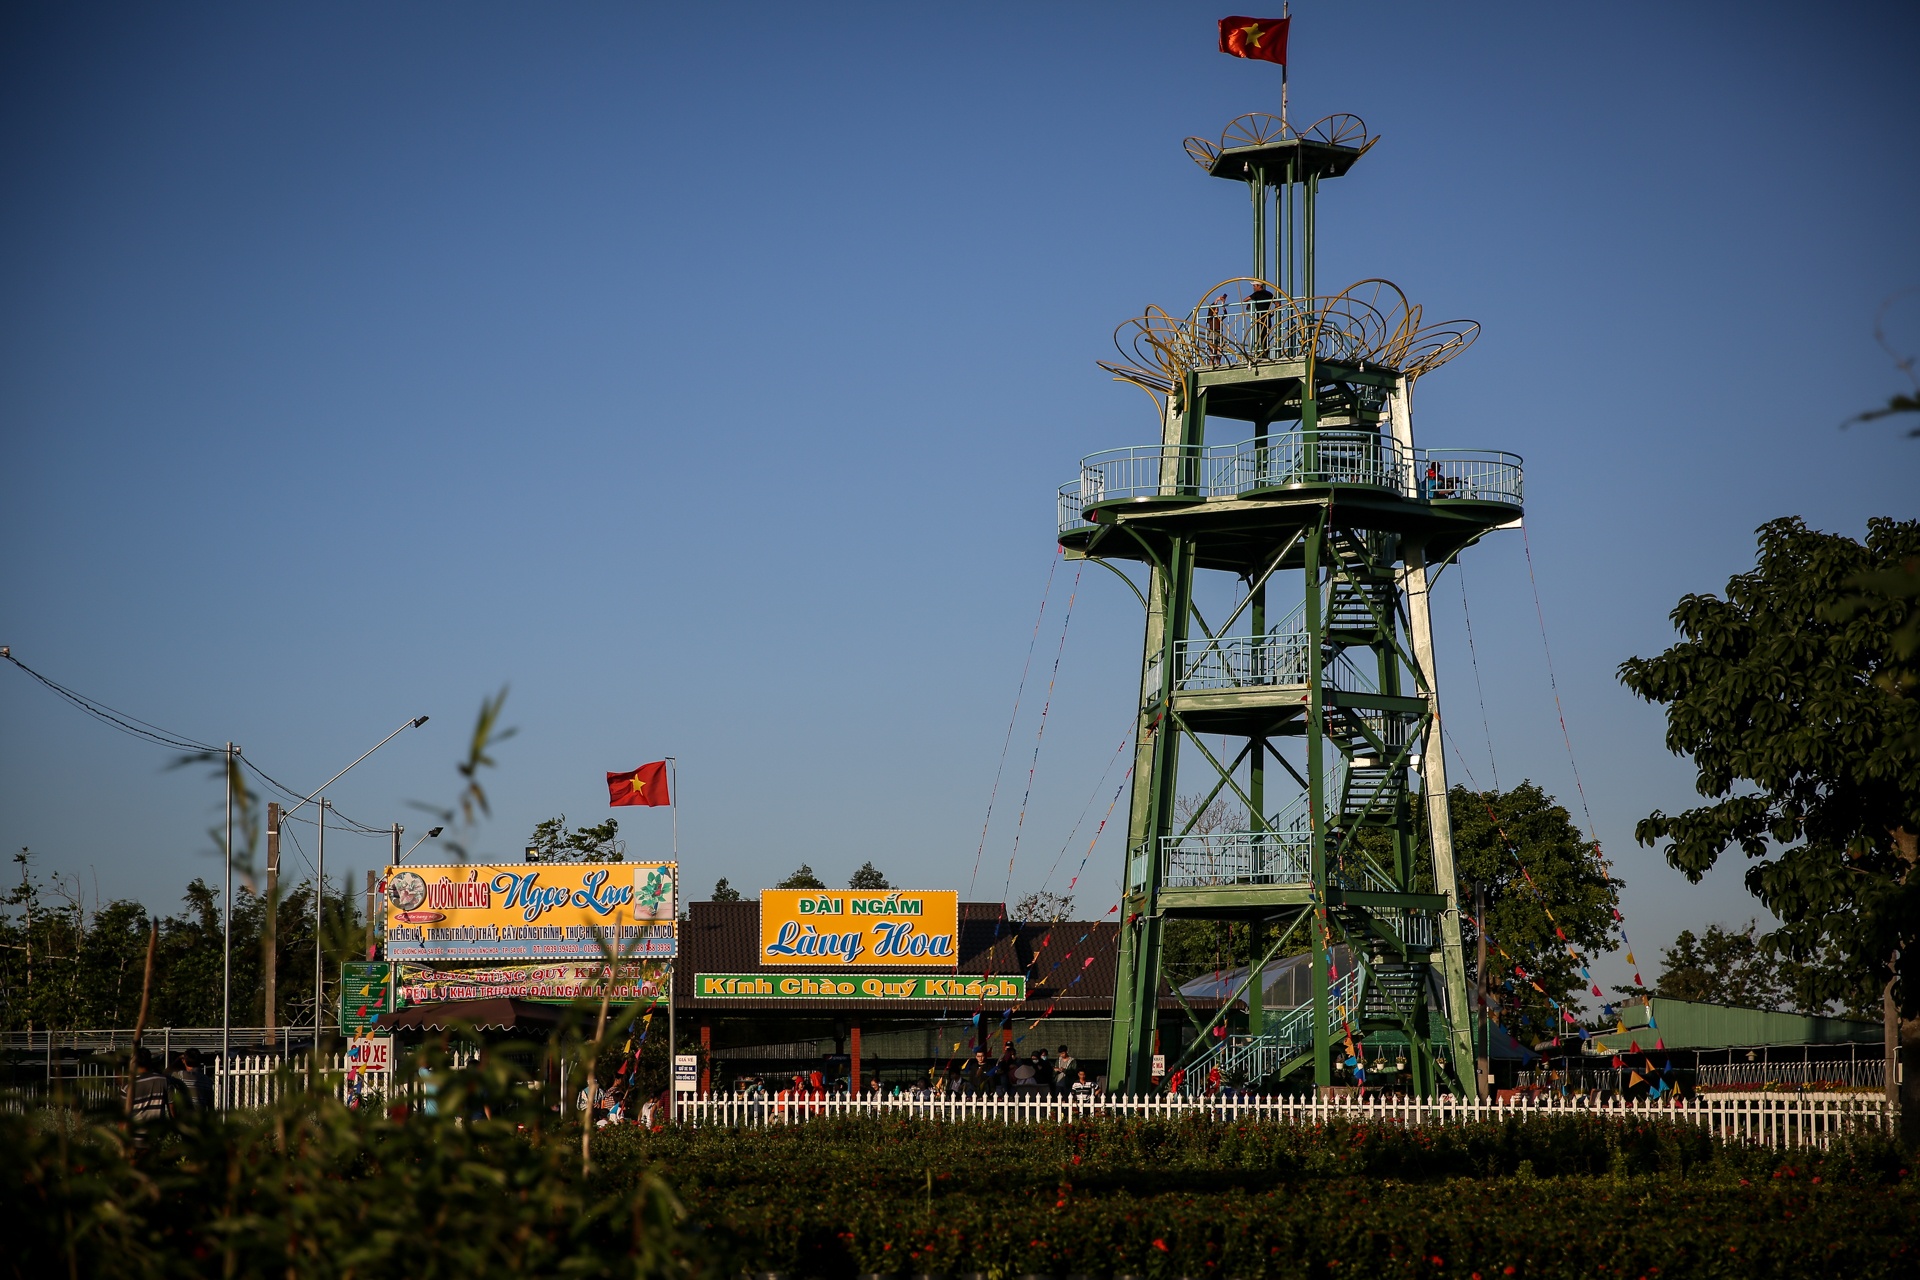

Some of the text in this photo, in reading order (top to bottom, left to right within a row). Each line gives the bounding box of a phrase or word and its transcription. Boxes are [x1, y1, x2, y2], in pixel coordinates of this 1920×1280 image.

[427, 869, 489, 908] VƯỜN KIỂNG
[490, 870, 632, 922] Ngọc Lan
[798, 893, 922, 915] ĐÀI NGẮM
[389, 925, 411, 941] KIỂNG
[427, 927, 451, 941] TRANG
[451, 925, 463, 941] TRÍ
[464, 925, 477, 943] NỘI
[502, 925, 517, 941] CÂY
[518, 925, 538, 940] CÔNG
[566, 925, 585, 942] THỰC
[624, 926, 639, 939] HOA
[661, 922, 674, 938] CỎ
[766, 921, 954, 962] Làng Hoa
[543, 945, 557, 953] 0939
[558, 944, 579, 953] 394220
[583, 944, 601, 953] 01259
[531, 966, 568, 982] QUÝ
[450, 986, 478, 998] KHAI
[530, 982, 552, 997] ĐÀI
[555, 981, 592, 997] NGẮM
[632, 985, 658, 997] HOA
[704, 978, 1018, 997] Kính Chào Quý Khách
[373, 1045, 387, 1063] XE
